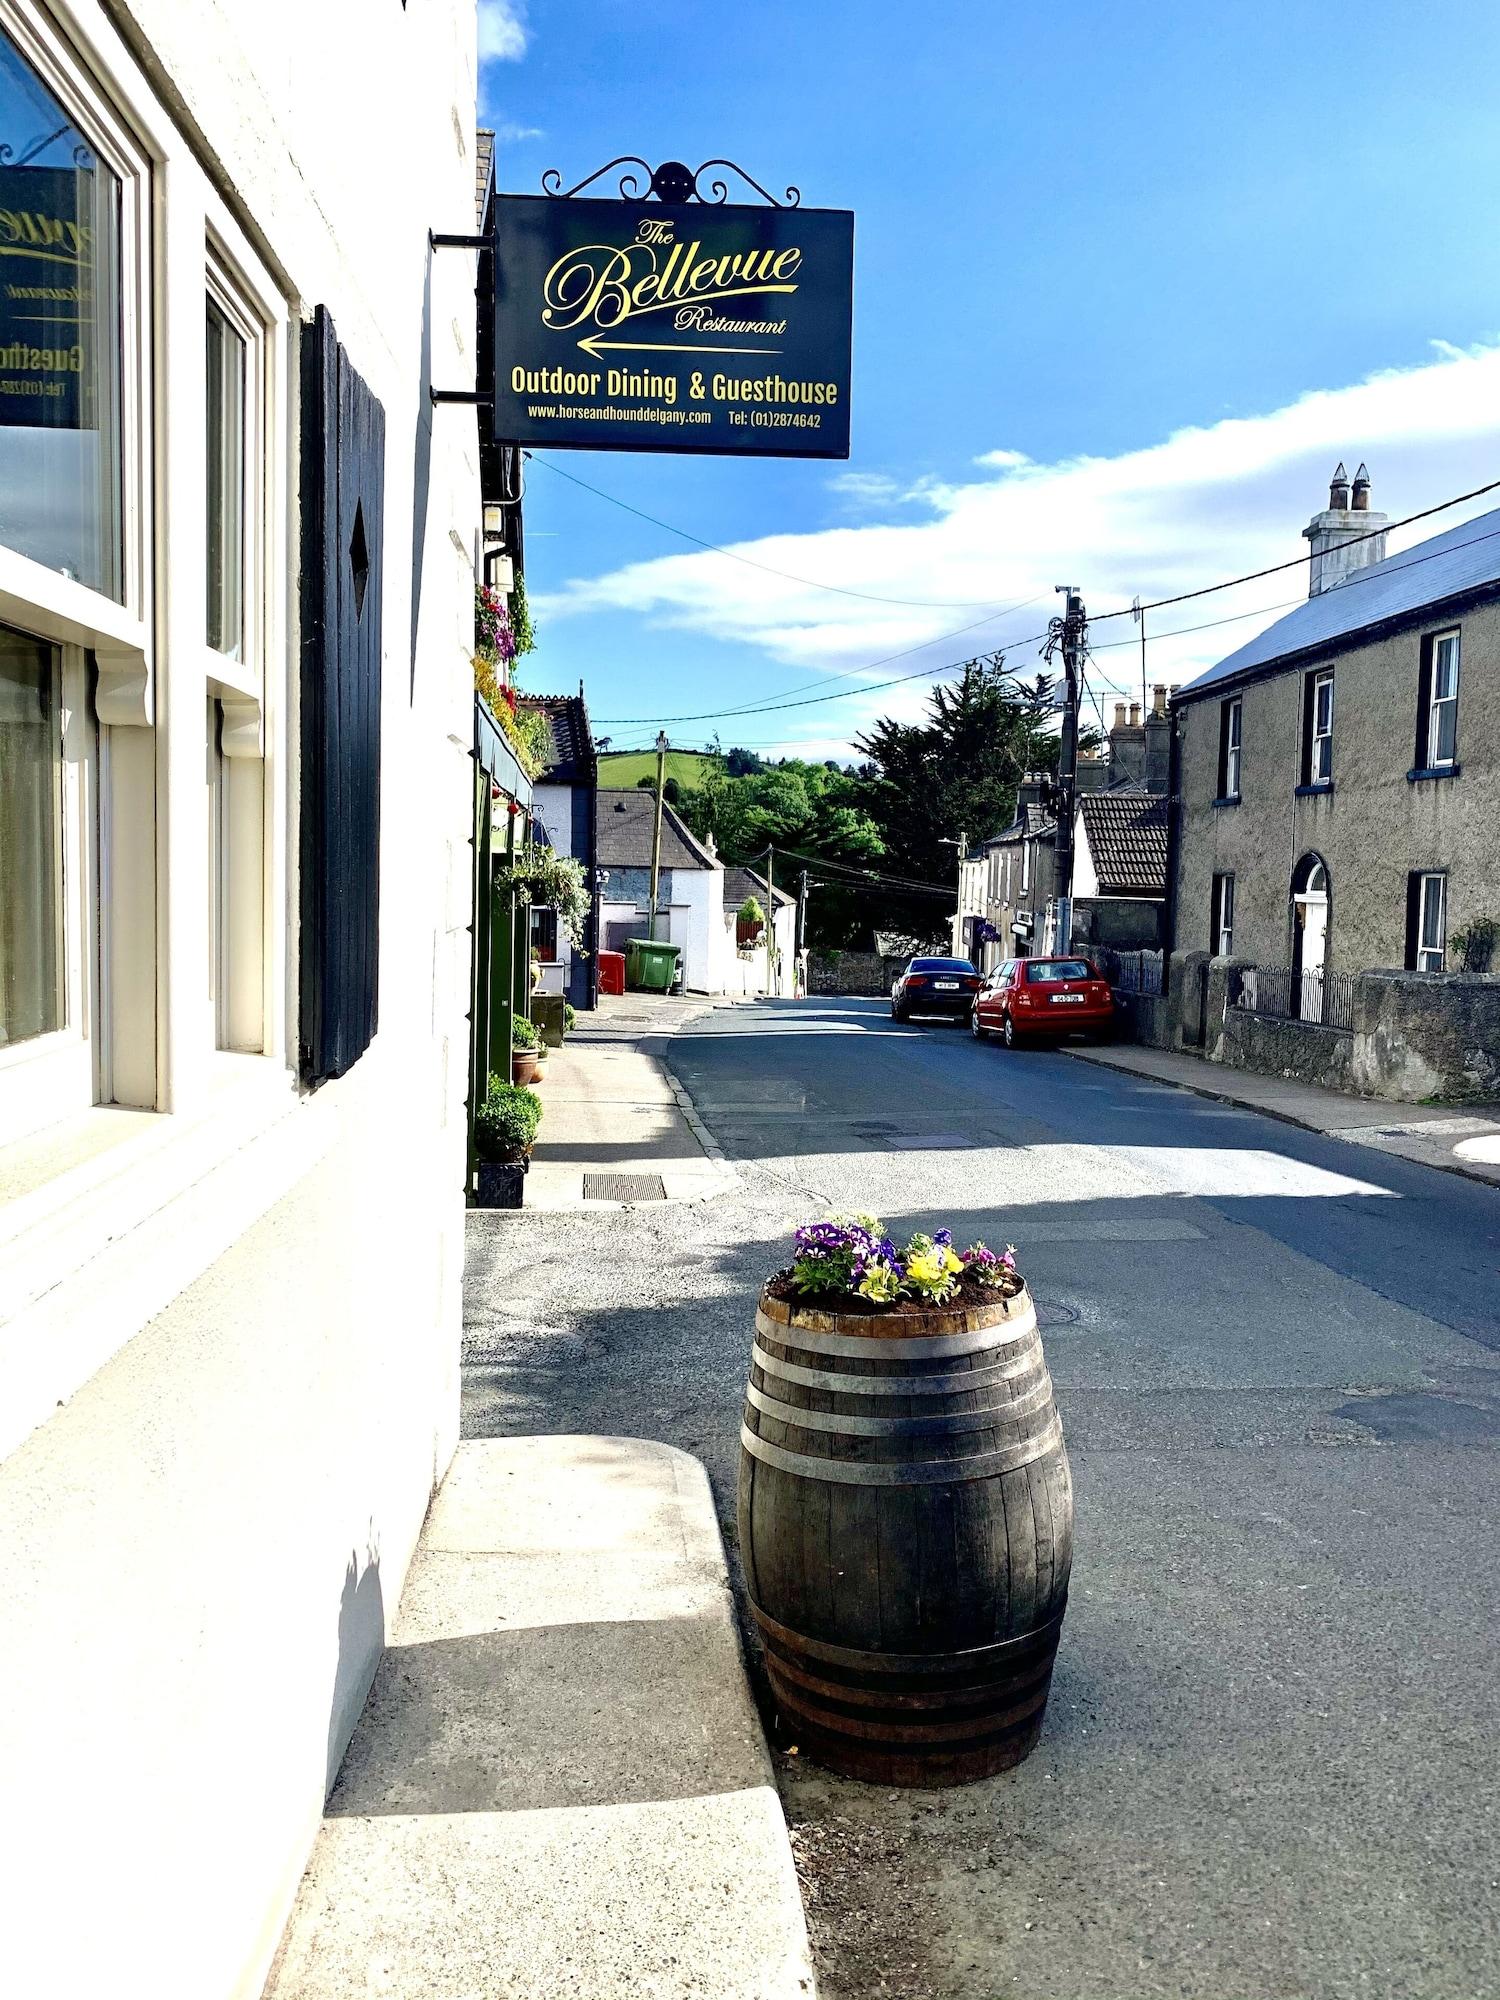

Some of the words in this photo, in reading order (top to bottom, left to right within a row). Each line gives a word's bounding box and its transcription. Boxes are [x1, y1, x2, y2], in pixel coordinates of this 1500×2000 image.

[635, 219, 674, 245] The
[541, 240, 803, 330] Bellevue
[674, 305, 787, 335] Restaurant
[511, 366, 601, 396] Outdoor
[607, 367, 677, 404] Dining
[689, 371, 706, 400] &
[712, 373, 838, 405] Guesthouse
[528, 403, 711, 425] www.horseandhounddelgany.com
[728, 410, 748, 426] Tel:
[750, 410, 821, 428] (01)2874642
